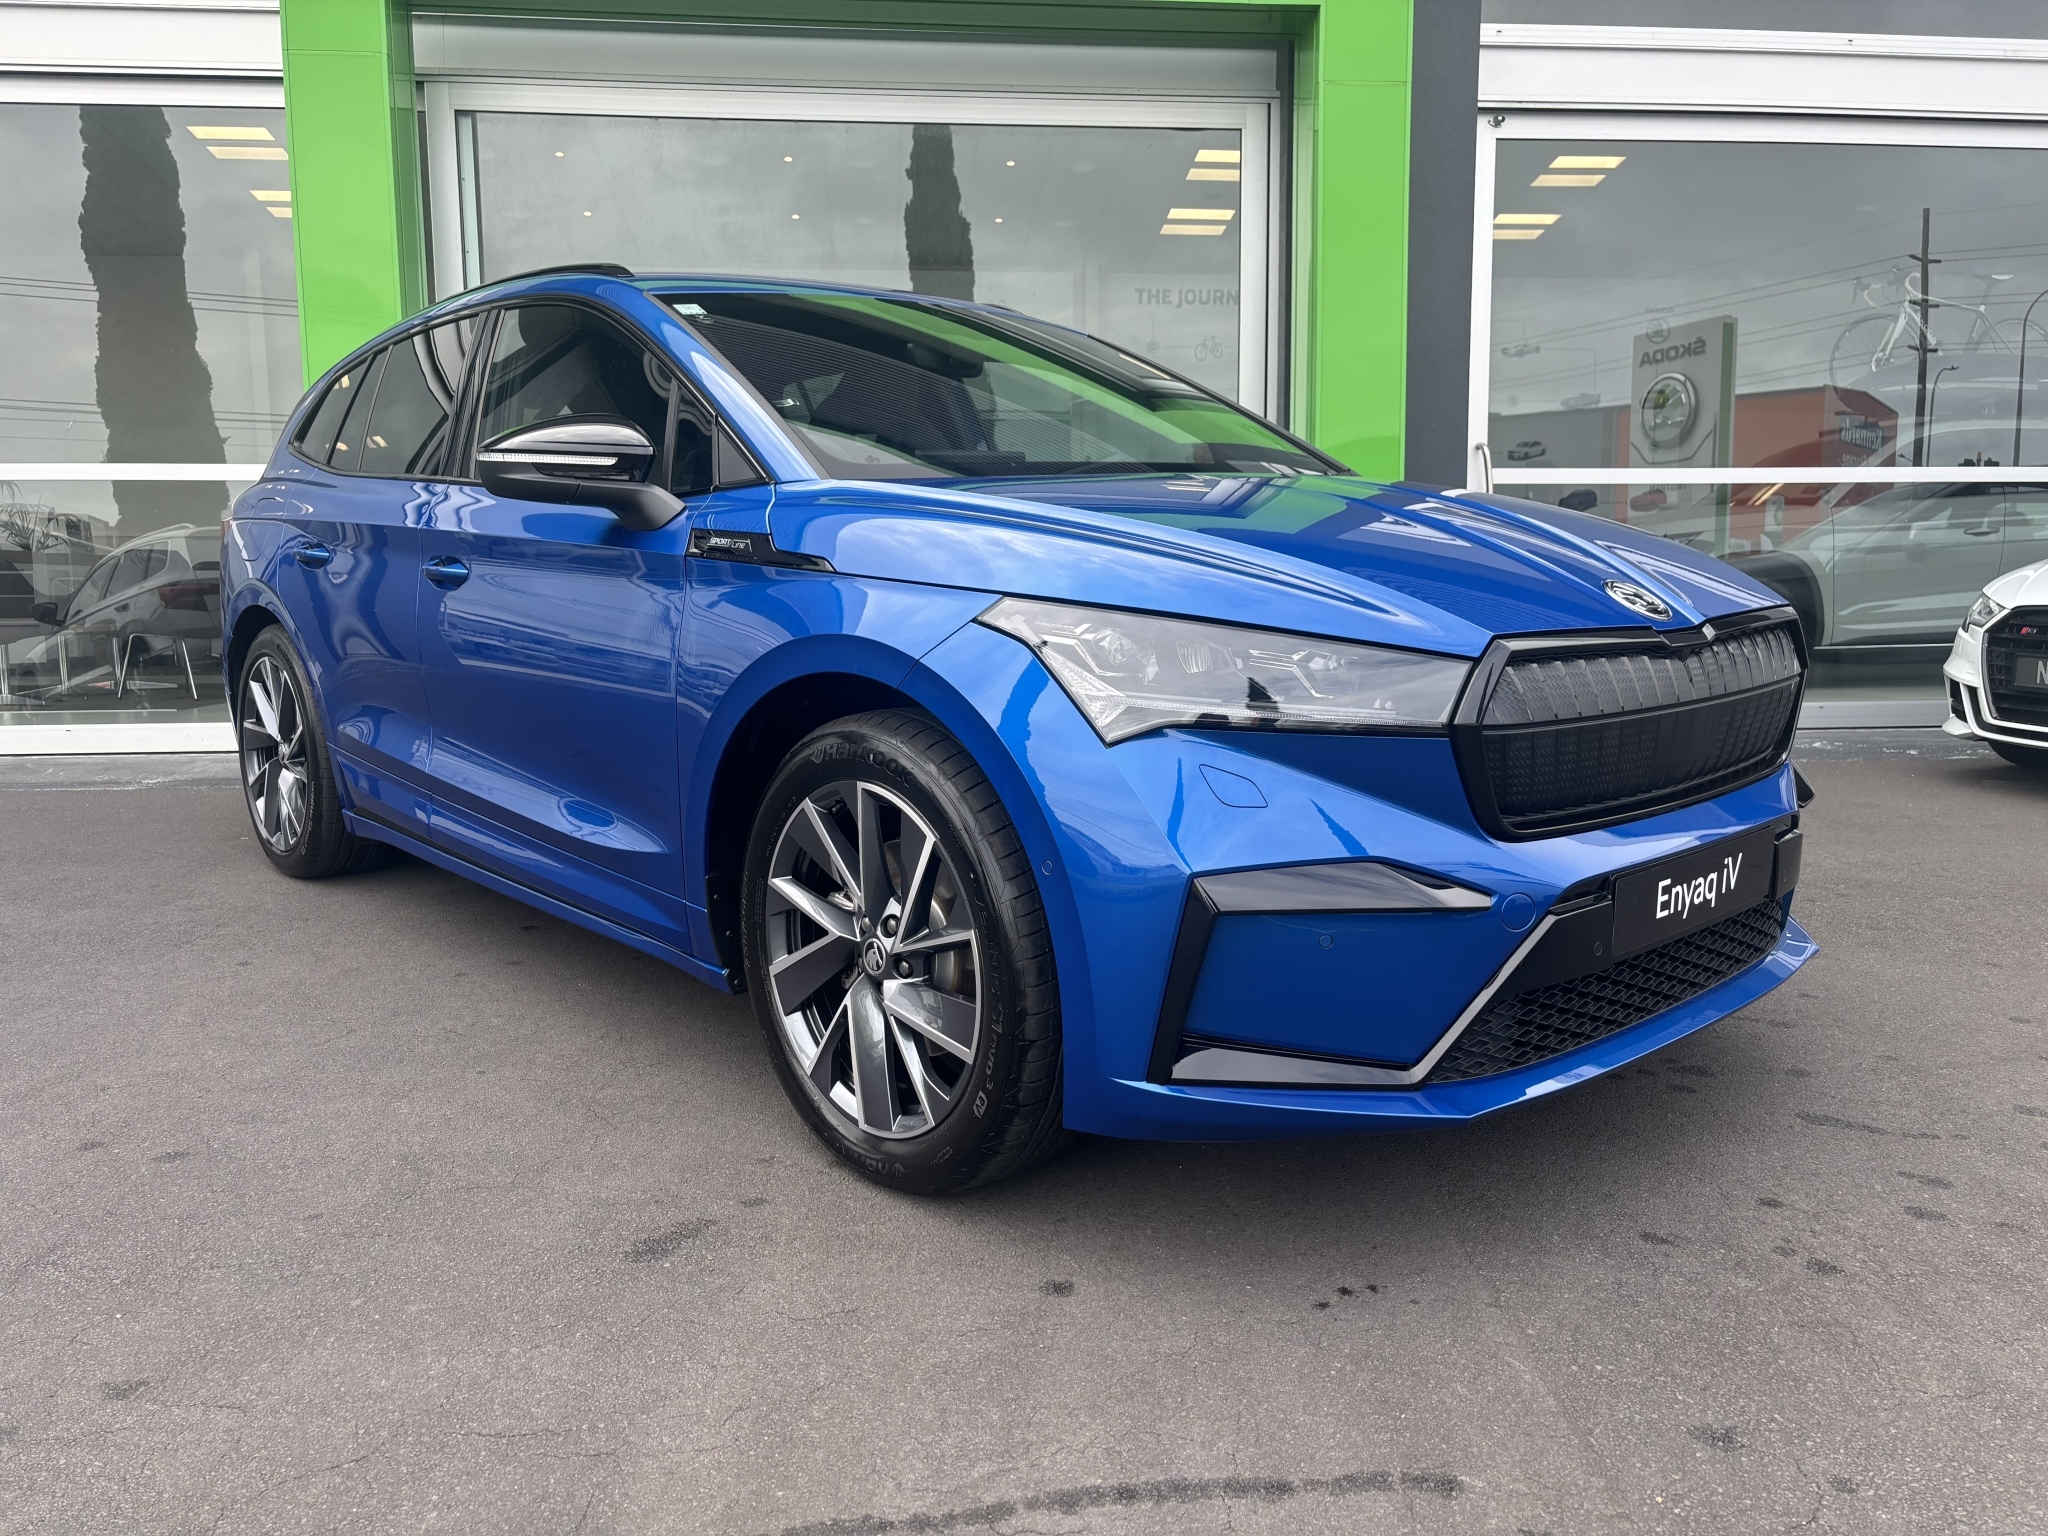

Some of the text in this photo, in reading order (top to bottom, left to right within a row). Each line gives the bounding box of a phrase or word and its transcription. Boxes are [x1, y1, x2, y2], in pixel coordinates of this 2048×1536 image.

[1134, 288, 1239, 309] THE JOURN
[710, 537, 731, 545] SPORT
[1656, 852, 1743, 919] Enyaq iV
